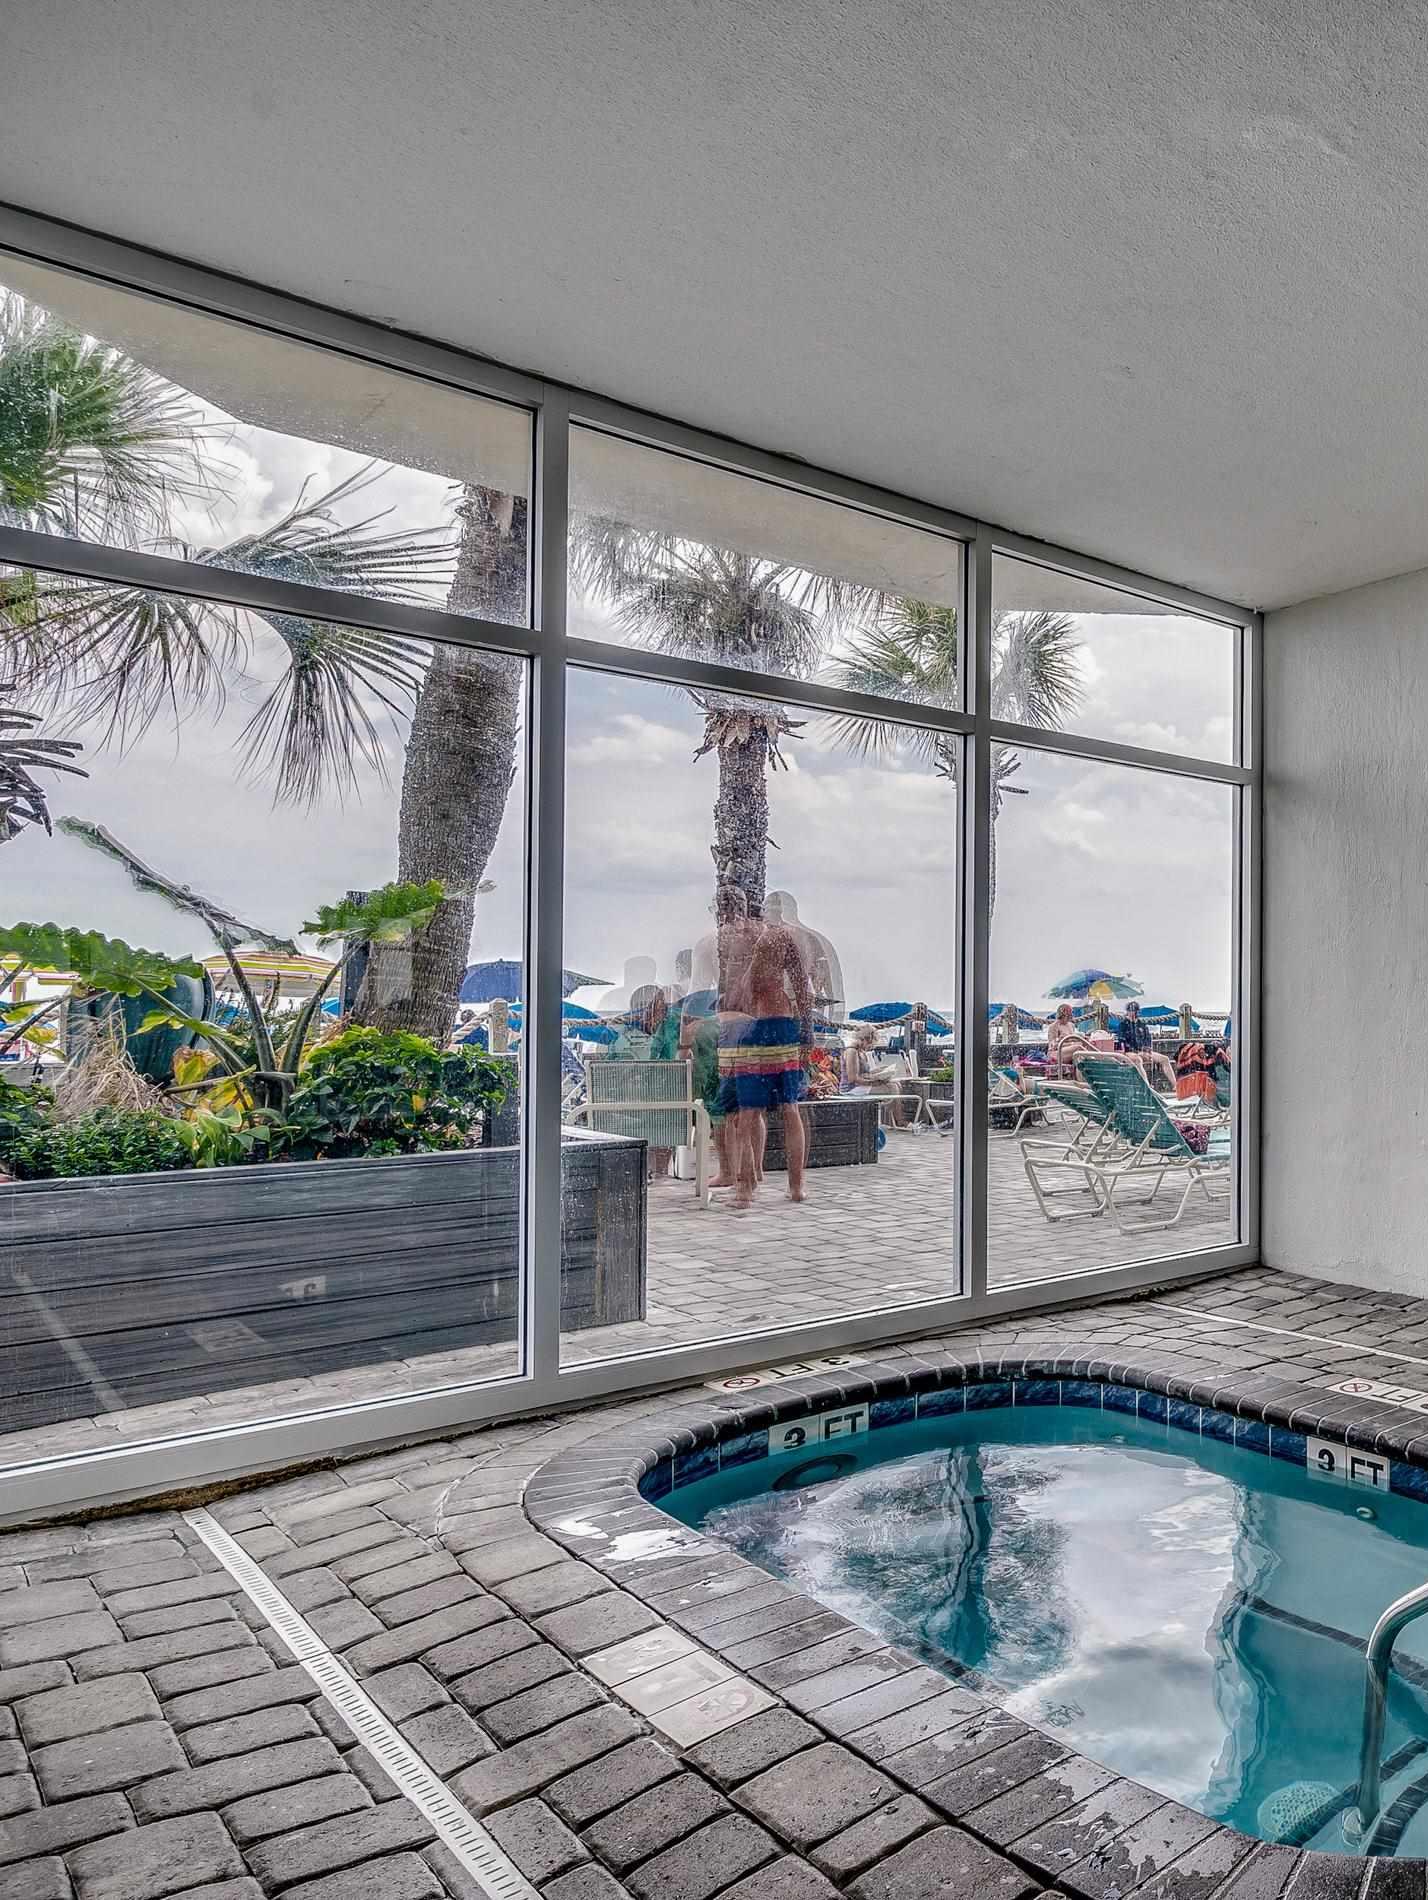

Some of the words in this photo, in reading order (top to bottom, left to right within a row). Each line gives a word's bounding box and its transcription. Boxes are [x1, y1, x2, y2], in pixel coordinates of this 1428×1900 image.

[820, 1356, 851, 1366] 3
[769, 1362, 816, 1380] FT
[1371, 1388, 1421, 1402] FT
[783, 1426, 806, 1449] 3
[825, 1410, 864, 1440] FT
[1318, 1448, 1335, 1472] 3
[1350, 1455, 1384, 1486] FT
